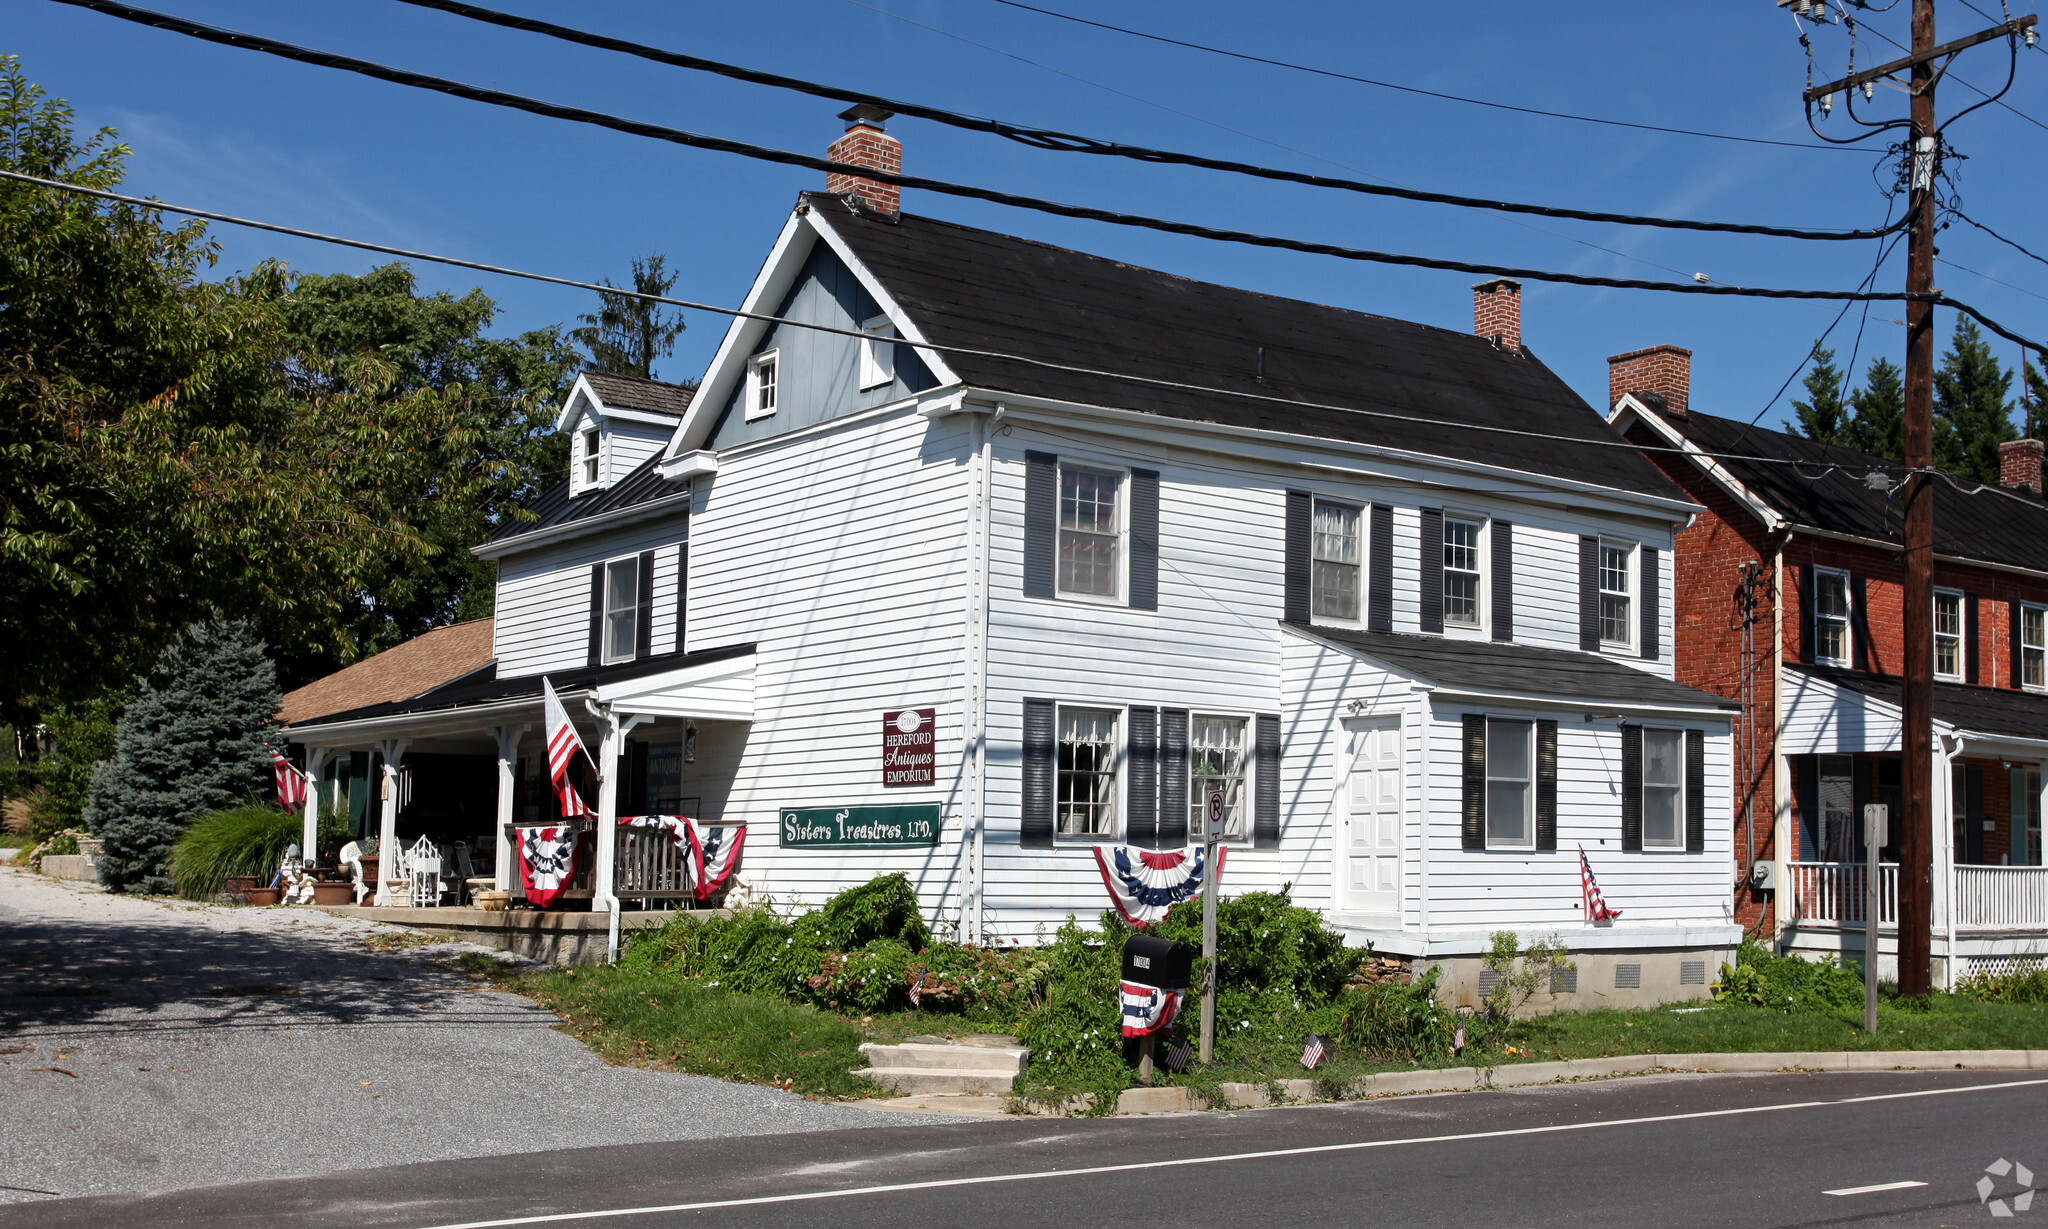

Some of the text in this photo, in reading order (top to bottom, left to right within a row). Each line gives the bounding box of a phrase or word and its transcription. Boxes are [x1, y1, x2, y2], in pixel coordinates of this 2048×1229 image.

[900, 716, 917, 727] 17004
[886, 732, 932, 747] HEREFORD
[884, 747, 934, 771] Antiques
[887, 769, 931, 783] EMPORIUM
[785, 813, 832, 841] Sisters
[1134, 955, 1150, 969] 17004
